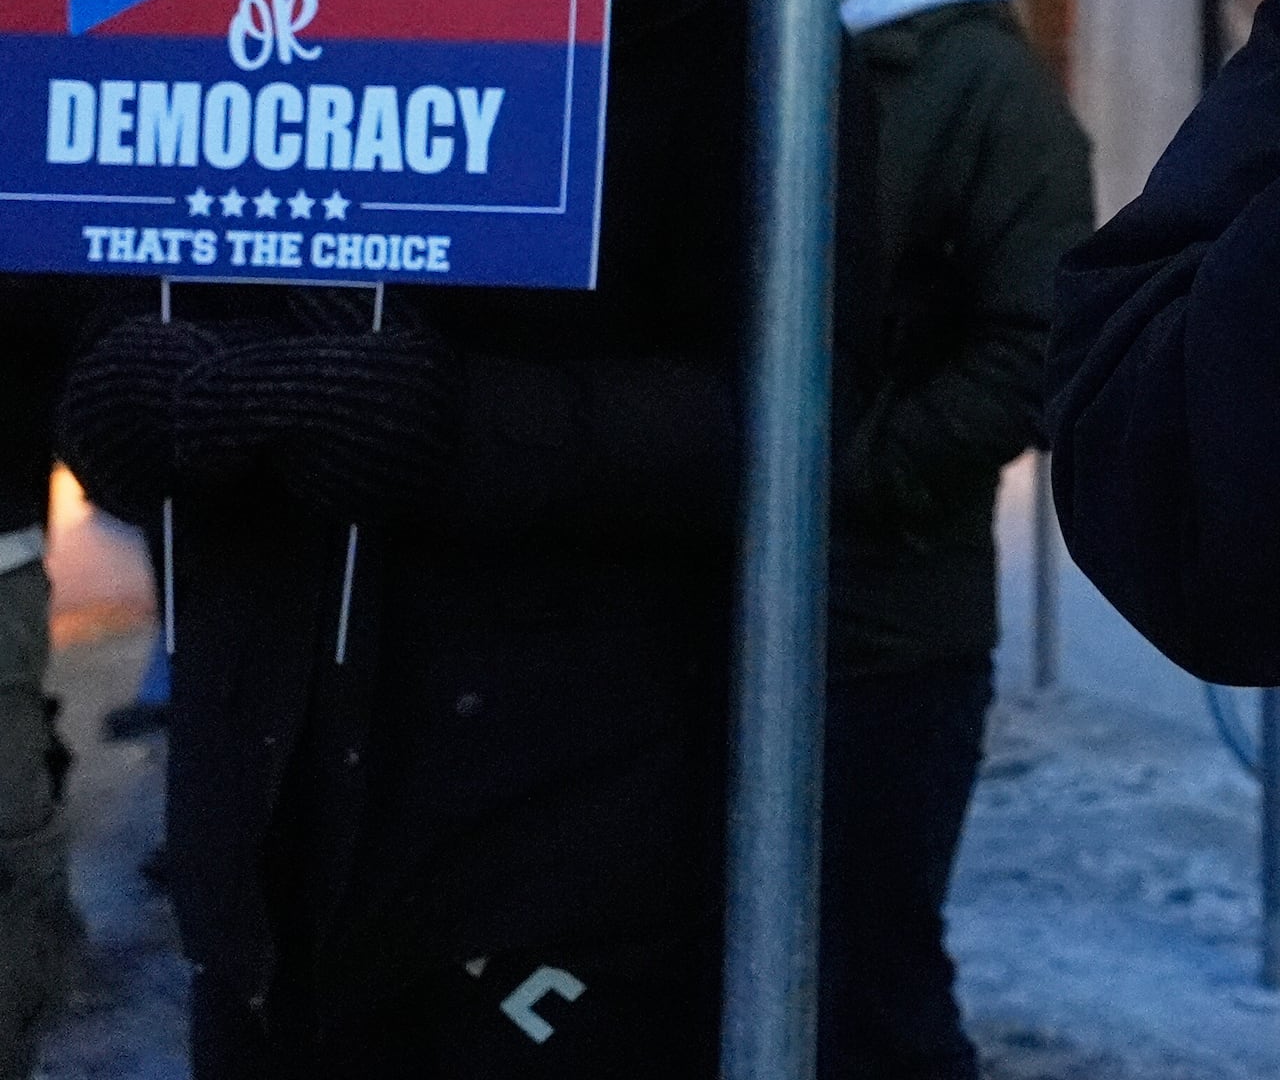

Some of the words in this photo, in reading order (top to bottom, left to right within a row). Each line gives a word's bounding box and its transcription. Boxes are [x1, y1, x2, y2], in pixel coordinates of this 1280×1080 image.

[45, 78, 505, 175] DEMOCRACY
[83, 226, 217, 265] THAT'S
[225, 230, 303, 269] THE
[309, 233, 452, 272] CHOICE
